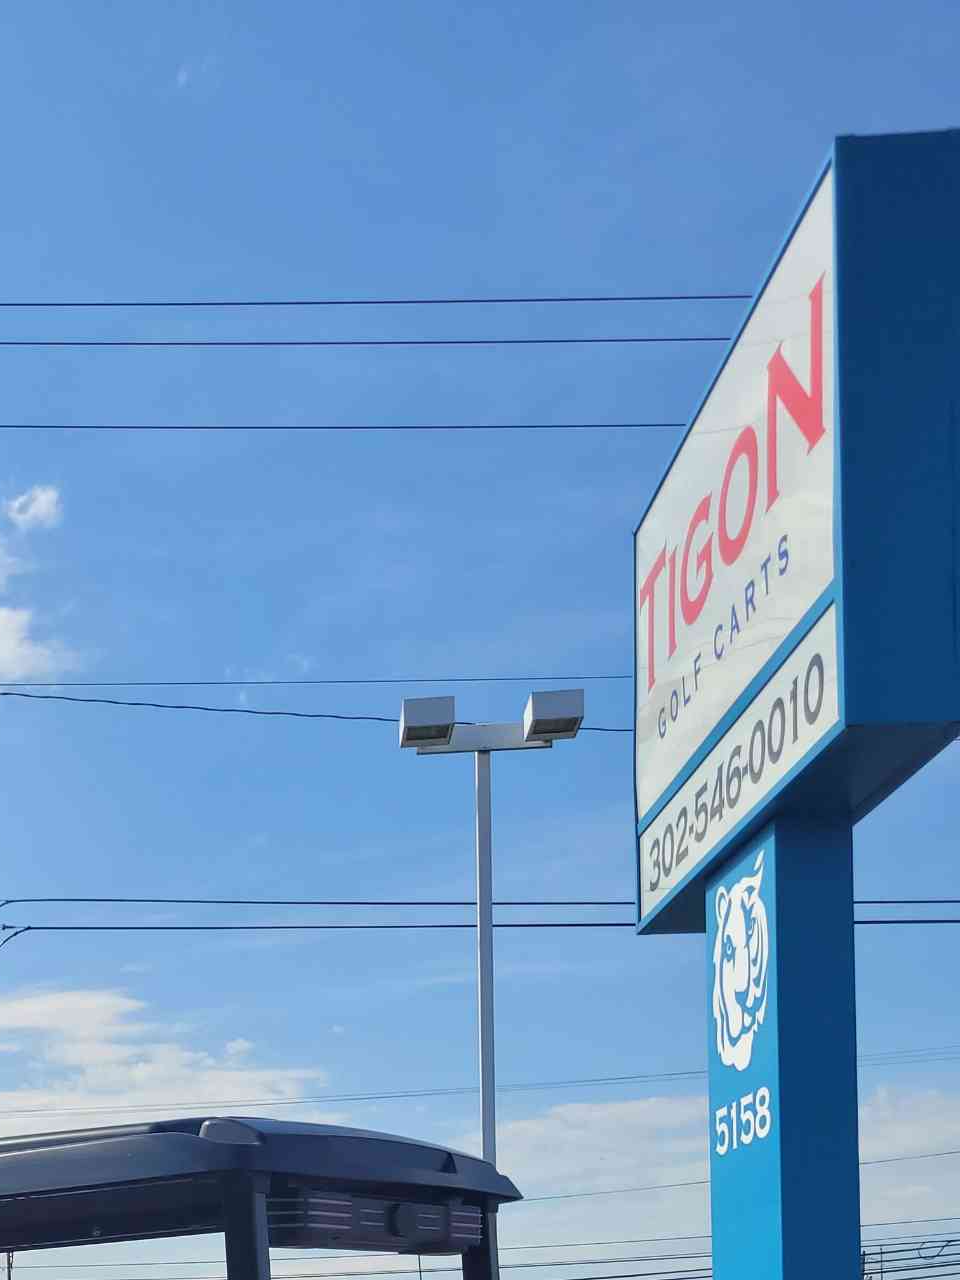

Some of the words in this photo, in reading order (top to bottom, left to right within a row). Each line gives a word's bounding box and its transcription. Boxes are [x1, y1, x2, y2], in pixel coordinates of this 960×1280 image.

[640, 270, 826, 694] TIGON
[658, 652, 702, 739] GOLF
[713, 533, 789, 661] CARTS
[649, 652, 825, 892] 302-546-0010
[715, 1086, 772, 1156] 5158
